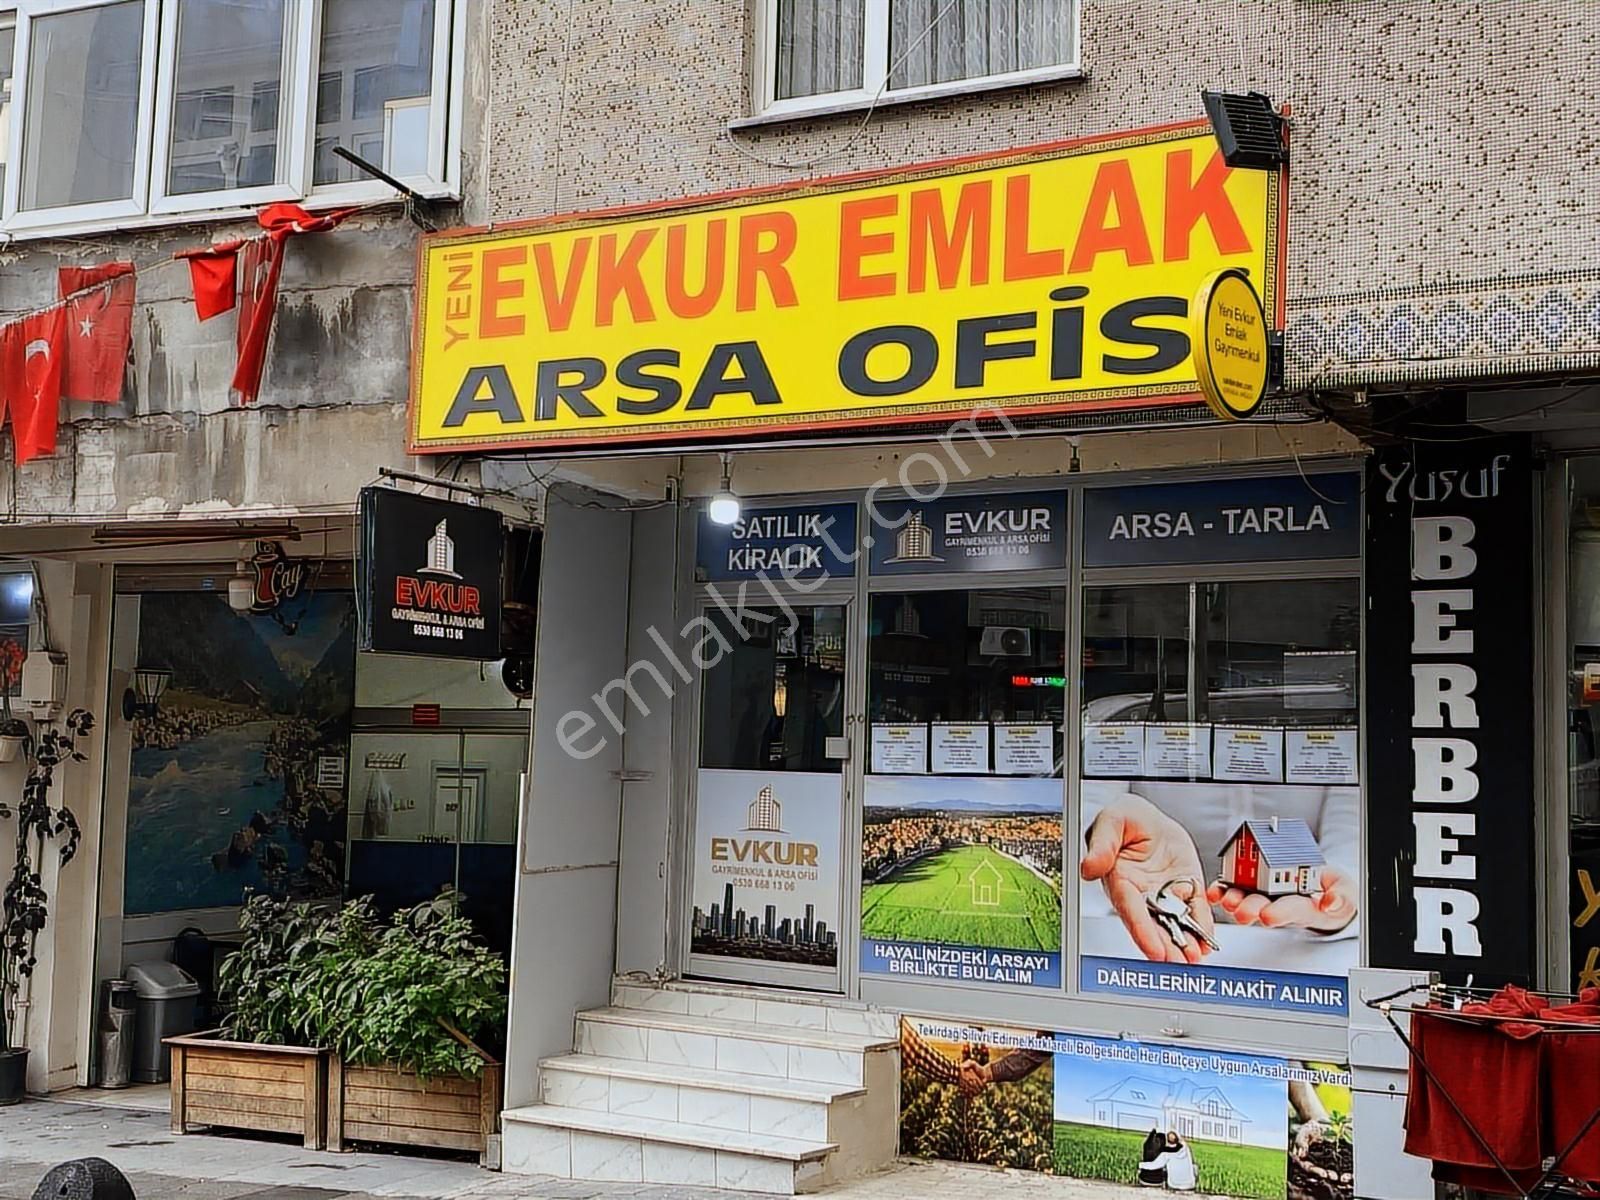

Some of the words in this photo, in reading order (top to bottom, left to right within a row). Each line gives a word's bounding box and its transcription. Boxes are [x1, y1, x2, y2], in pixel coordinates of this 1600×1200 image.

[478, 211, 799, 340] EVKUR
[837, 148, 1252, 301] EMLAK
[443, 251, 474, 352] YENİ
[1218, 301, 1233, 319] Yeni
[1225, 323, 1247, 341] Emlak
[442, 340, 784, 429] ARSA
[837, 285, 1192, 398] OFİS
[1379, 454, 1511, 503] Yusuf
[731, 513, 821, 540] SATILIK
[946, 508, 1051, 535] EVKUR
[1109, 511, 1195, 540] ARSA
[1222, 504, 1330, 534] TARLA
[1007, 534, 1029, 545] ARSA
[728, 543, 822, 571] KİRALIK
[397, 576, 481, 615] EVKUR
[1411, 515, 1482, 958] BERBER
[712, 838, 818, 867] EVKUR
[733, 878, 752, 889] 0530
[773, 881, 782, 891] 13
[774, 868, 796, 881] ARSA
[874, 943, 988, 967] HAYALİNİZDEKİ
[990, 954, 1050, 970] ARSAYI
[962, 965, 1033, 985] BULALIM
[1097, 968, 1218, 998] DAİRELERİNİZ
[1221, 977, 1277, 1000] NAKİT
[1277, 985, 1343, 1007] ALINIR
[1140, 1048, 1159, 1062] Her
[1162, 1051, 1208, 1071] Bütçeye
[1211, 1056, 1249, 1075] Uygun
